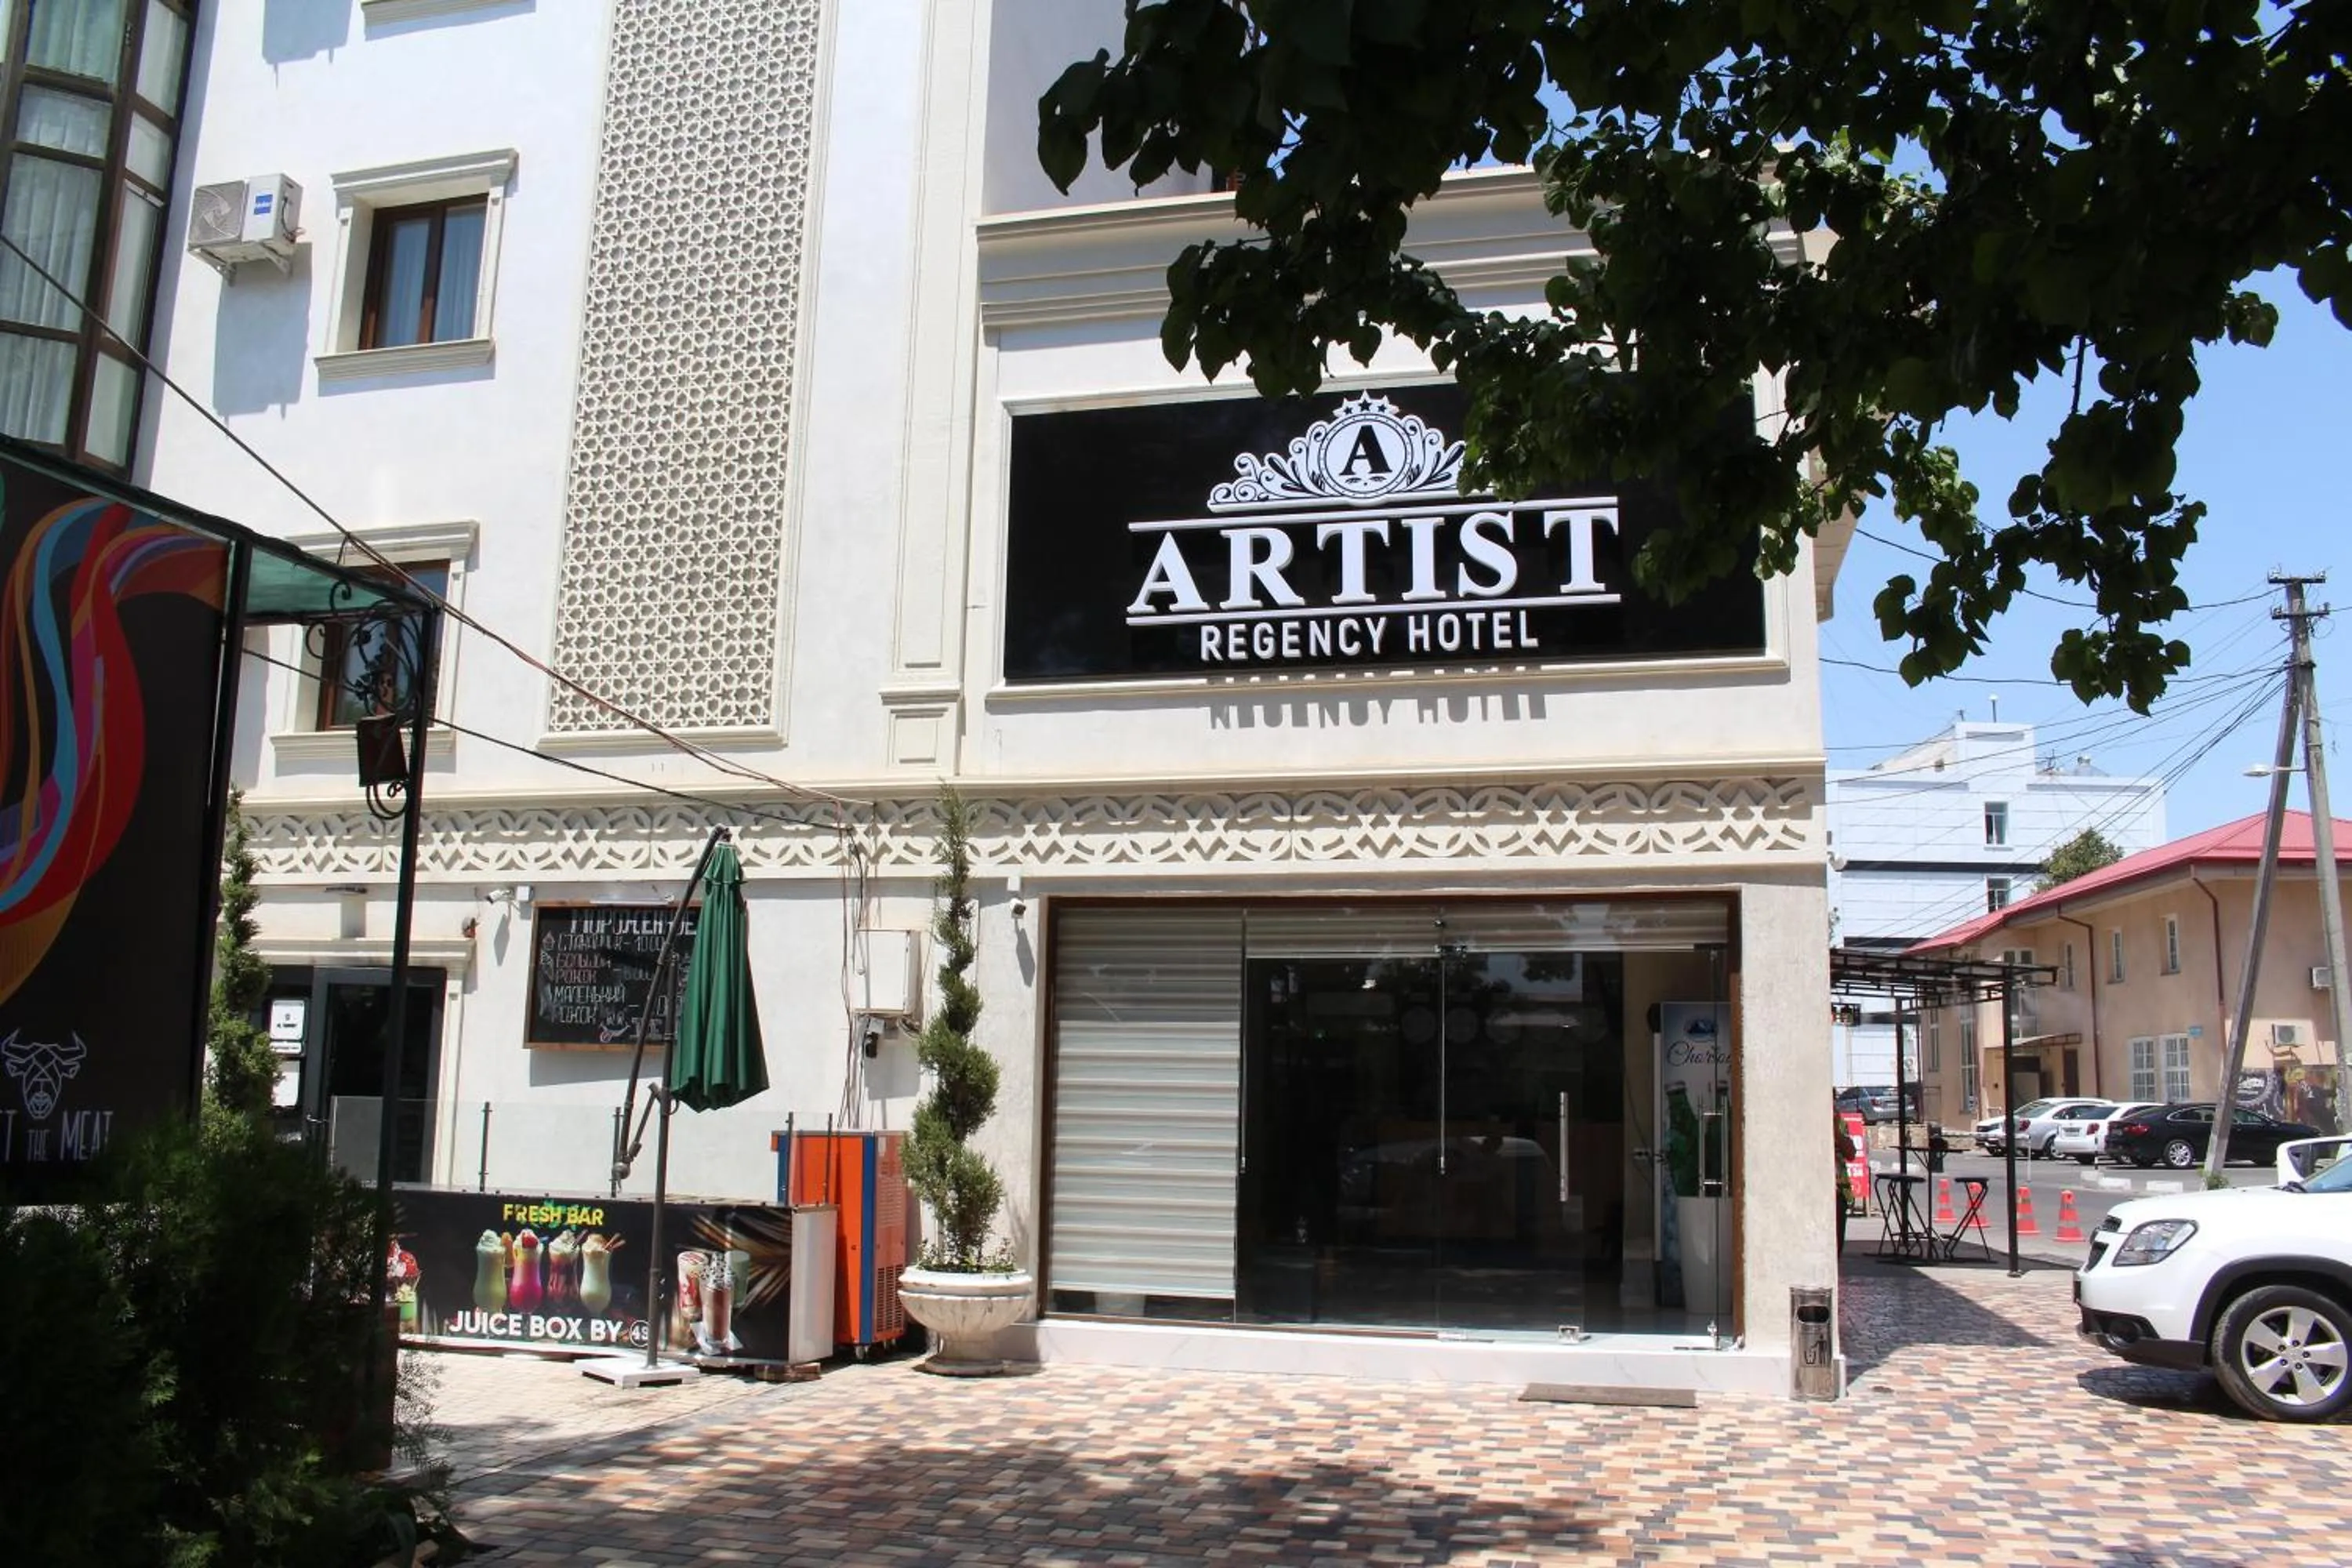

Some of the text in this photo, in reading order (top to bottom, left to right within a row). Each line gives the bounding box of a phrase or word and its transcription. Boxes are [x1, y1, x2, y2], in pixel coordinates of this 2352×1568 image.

[1339, 424, 1393, 476] A
[1127, 508, 1620, 614] ARTIST
[1200, 609, 1539, 662] REGENCY HOTEL
[27, 1129, 50, 1162] THE
[60, 1110, 114, 1161] MEAT
[503, 1203, 604, 1225] FRESH BAR
[449, 1310, 522, 1336] JUICE
[530, 1315, 583, 1340] BOX
[590, 1319, 623, 1342] BY
